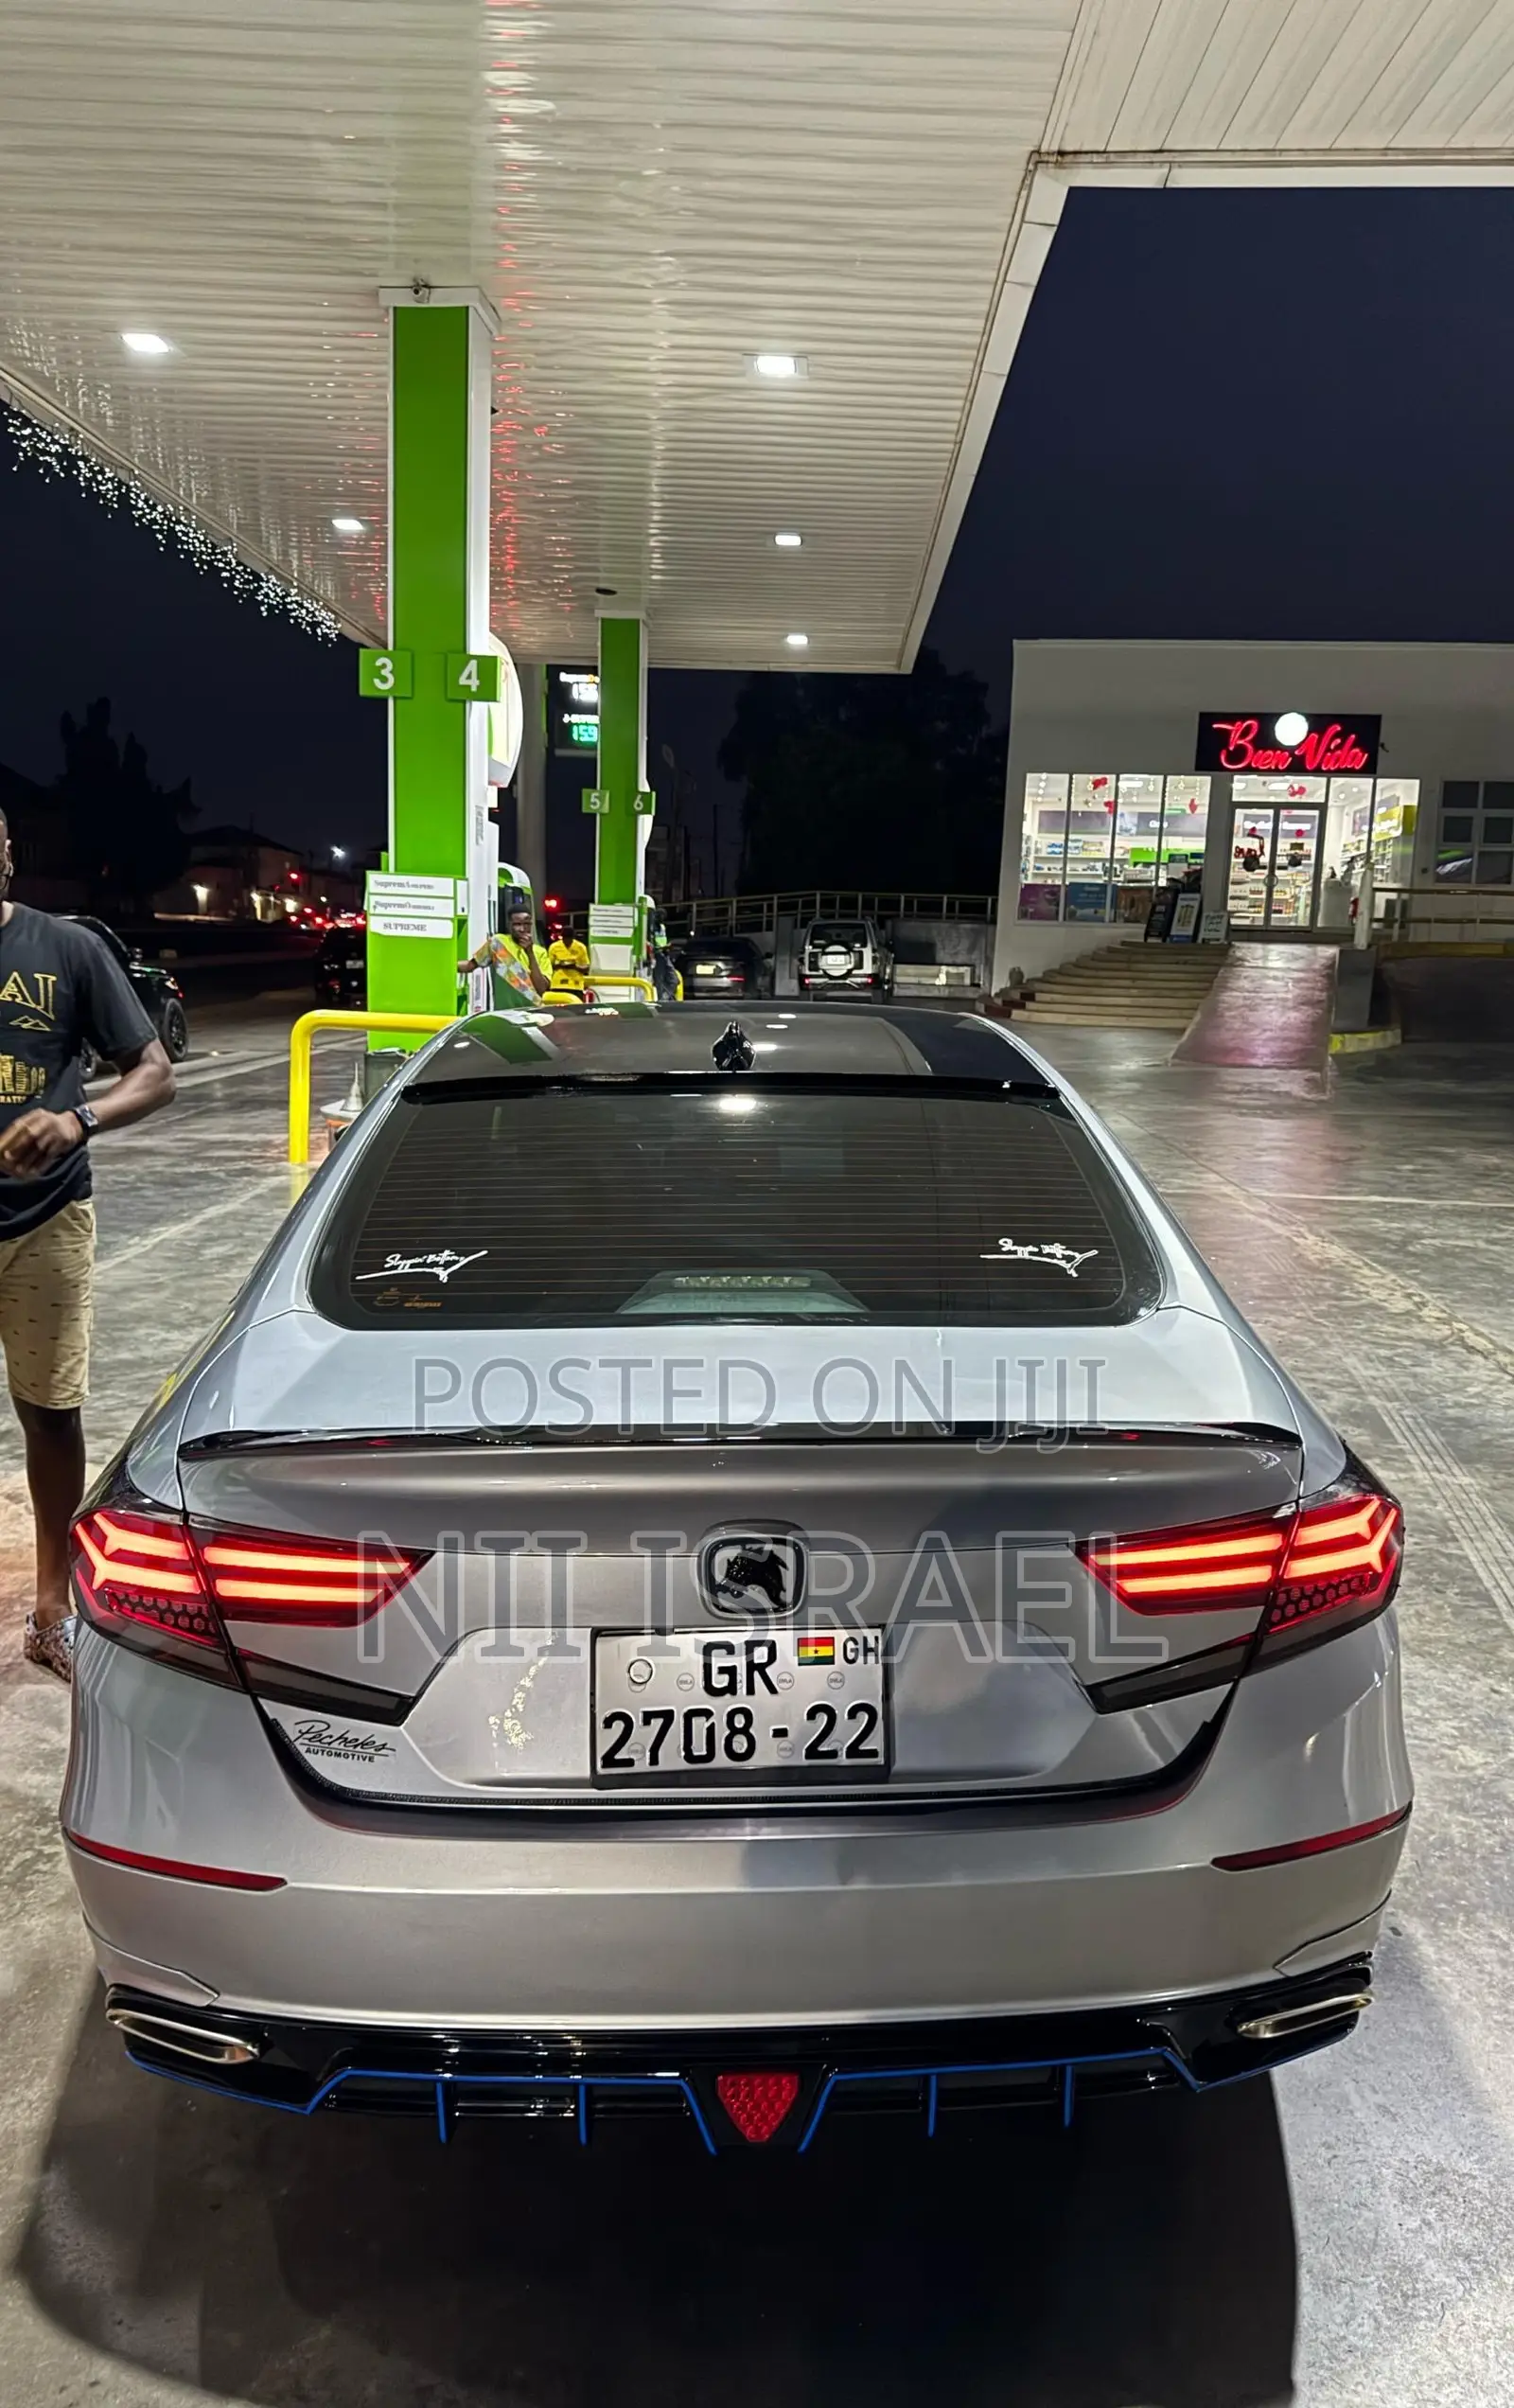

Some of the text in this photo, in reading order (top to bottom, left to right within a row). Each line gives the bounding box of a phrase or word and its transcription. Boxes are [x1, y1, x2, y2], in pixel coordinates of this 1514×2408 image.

[373, 657, 395, 690] 3
[458, 659, 480, 692] 4
[1294, 723, 1368, 770] Vida
[590, 792, 600, 809] 5
[633, 794, 644, 811] 6
[842, 1636, 879, 1665] GH
[703, 1639, 779, 1696] GR
[292, 1720, 396, 1752] Pecheles
[305, 1746, 376, 1762] AUTOMOTIVE
